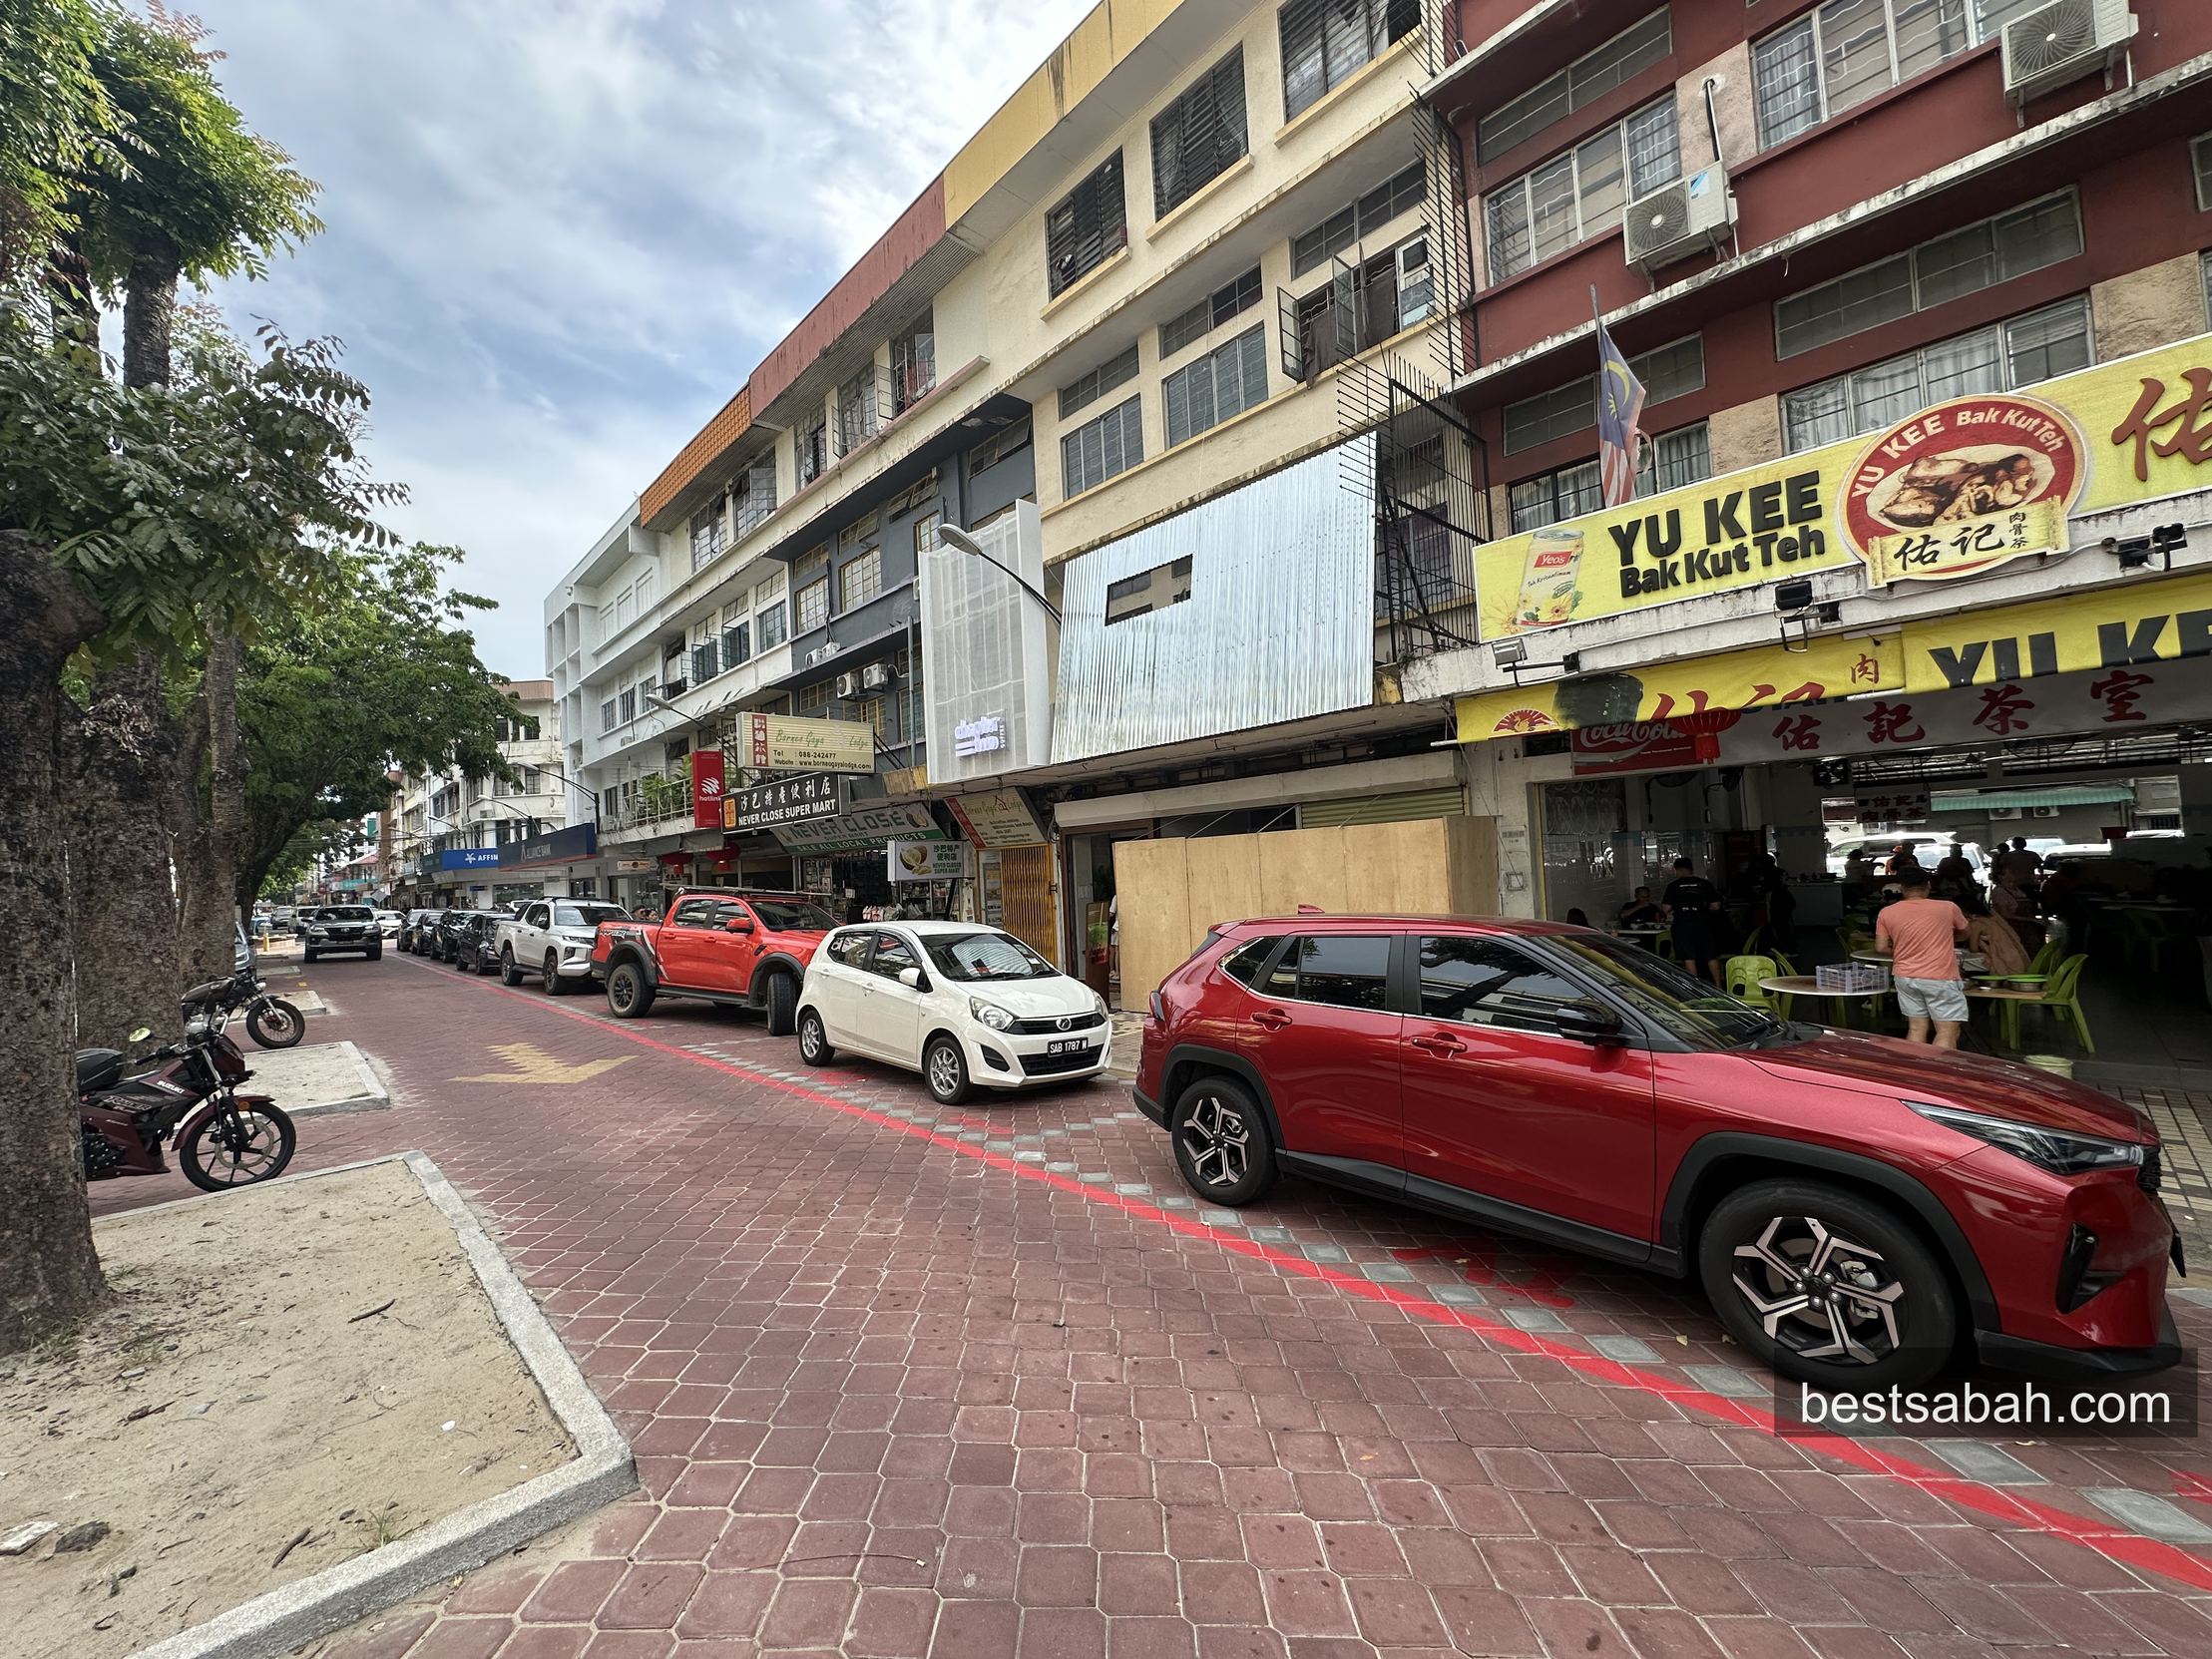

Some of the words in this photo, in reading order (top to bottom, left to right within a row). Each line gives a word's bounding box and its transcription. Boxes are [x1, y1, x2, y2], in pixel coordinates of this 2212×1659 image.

[1851, 465, 1885, 498] YU
[1881, 414, 1945, 459] KEE
[1956, 407, 2000, 427] Bak
[2002, 409, 2041, 433] Kut
[2035, 421, 2065, 453] Teh
[1607, 508, 1682, 567] YU
[1703, 470, 1823, 545] KEE
[1541, 554, 1566, 566] Yeo's
[1619, 559, 1681, 599] Bak
[1684, 542, 1750, 584] Kut
[1752, 524, 1825, 567] Teh
[1894, 523, 2005, 572] 佑记
[1851, 653, 1879, 684] 肉
[738, 812, 760, 827] NEVER
[761, 809, 784, 823] CLOSE
[785, 803, 811, 818] SUPER
[812, 799, 836, 814] MART
[788, 818, 843, 839] NEVER
[842, 809, 906, 832] CLOSE
[838, 839, 868, 848] LOCAL
[1050, 1042, 1063, 1053] SAB
[1065, 1039, 1081, 1052] 1787
[157, 1079, 185, 1094] SUZUKI
